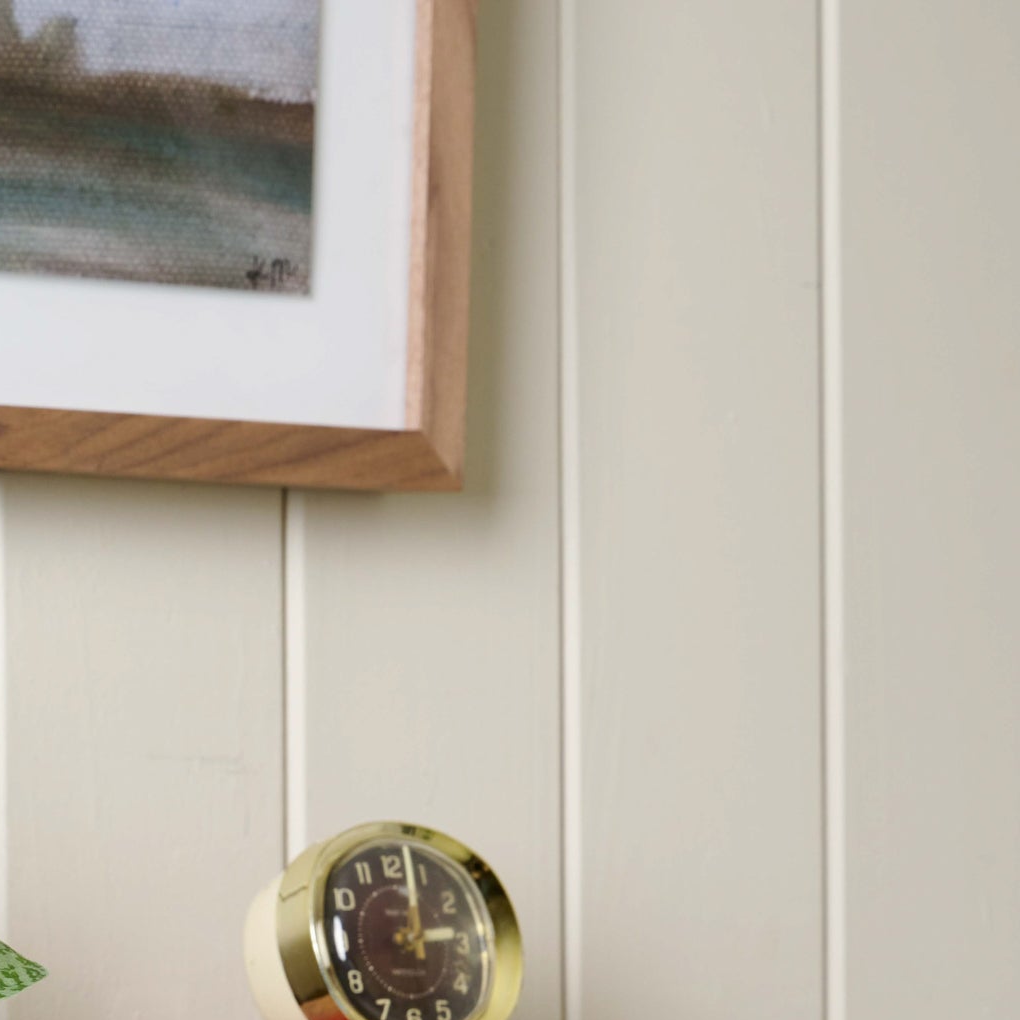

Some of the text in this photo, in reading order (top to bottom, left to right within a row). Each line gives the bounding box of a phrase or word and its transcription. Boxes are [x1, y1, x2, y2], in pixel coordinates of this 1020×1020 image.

[355, 862, 372, 885] 11
[380, 855, 402, 878] 12
[419, 863, 427, 886] 1
[333, 888, 356, 911] 10
[442, 891, 456, 914] 2
[456, 932, 470, 955] 3
[347, 969, 364, 994] 8
[453, 972, 468, 994] 4
